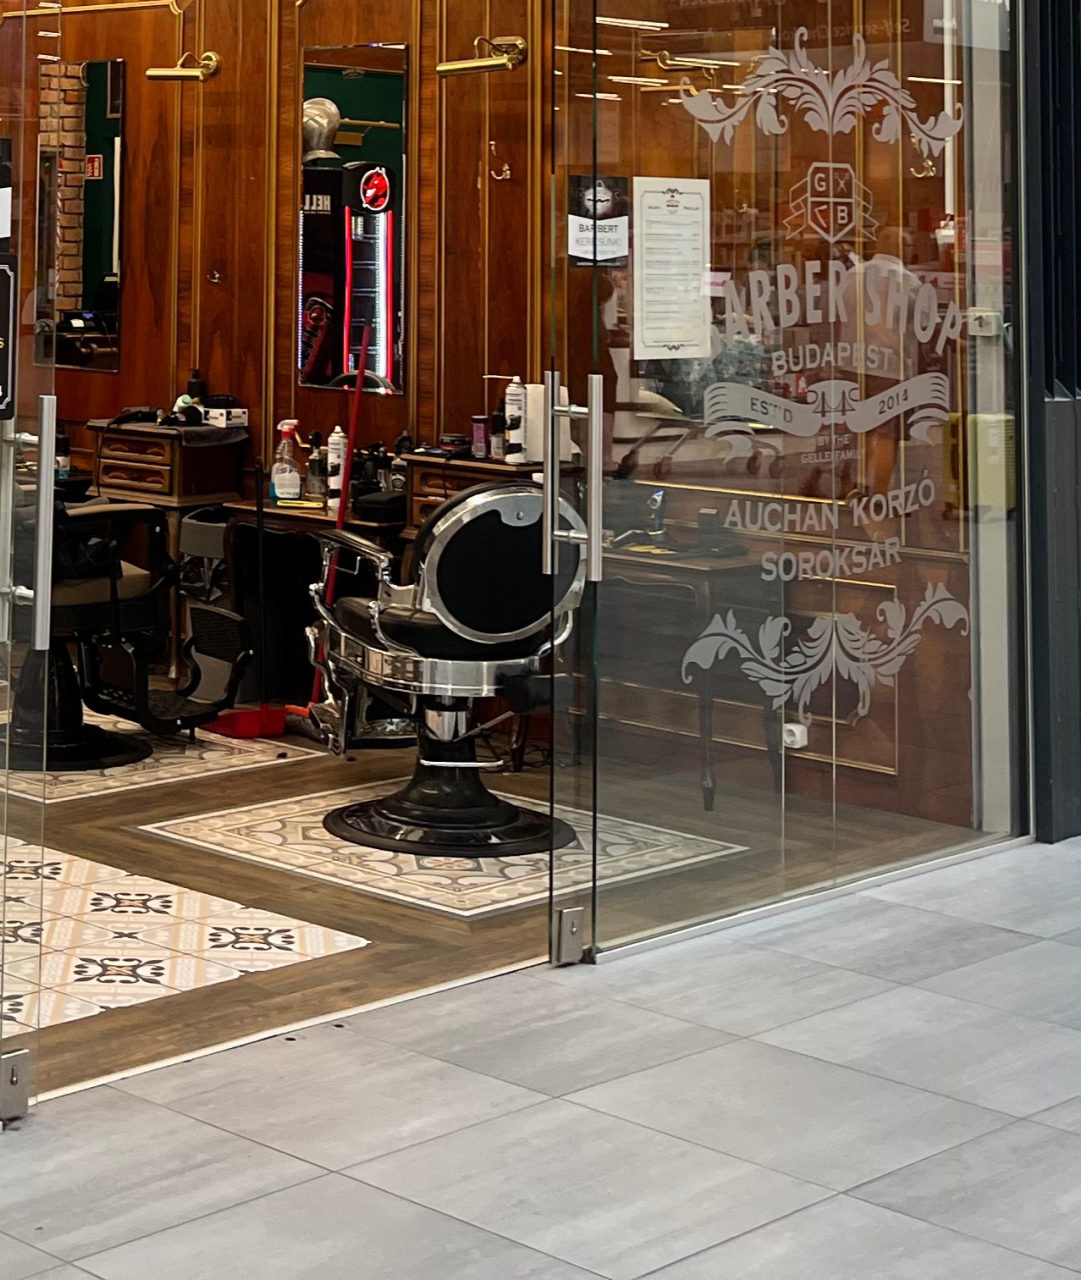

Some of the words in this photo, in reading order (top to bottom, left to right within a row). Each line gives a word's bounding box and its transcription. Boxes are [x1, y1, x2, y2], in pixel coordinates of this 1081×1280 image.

[814, 173, 826, 192] G
[837, 206, 848, 224] B
[709, 260, 848, 362] ARBER
[865, 263, 962, 355] SHOP
[772, 343, 893, 376] BUDAPEST
[878, 389, 909, 415] 2014
[835, 448, 864, 461] FAMI
[723, 500, 838, 532] AUCHAN
[850, 469, 935, 526] KORZÓ
